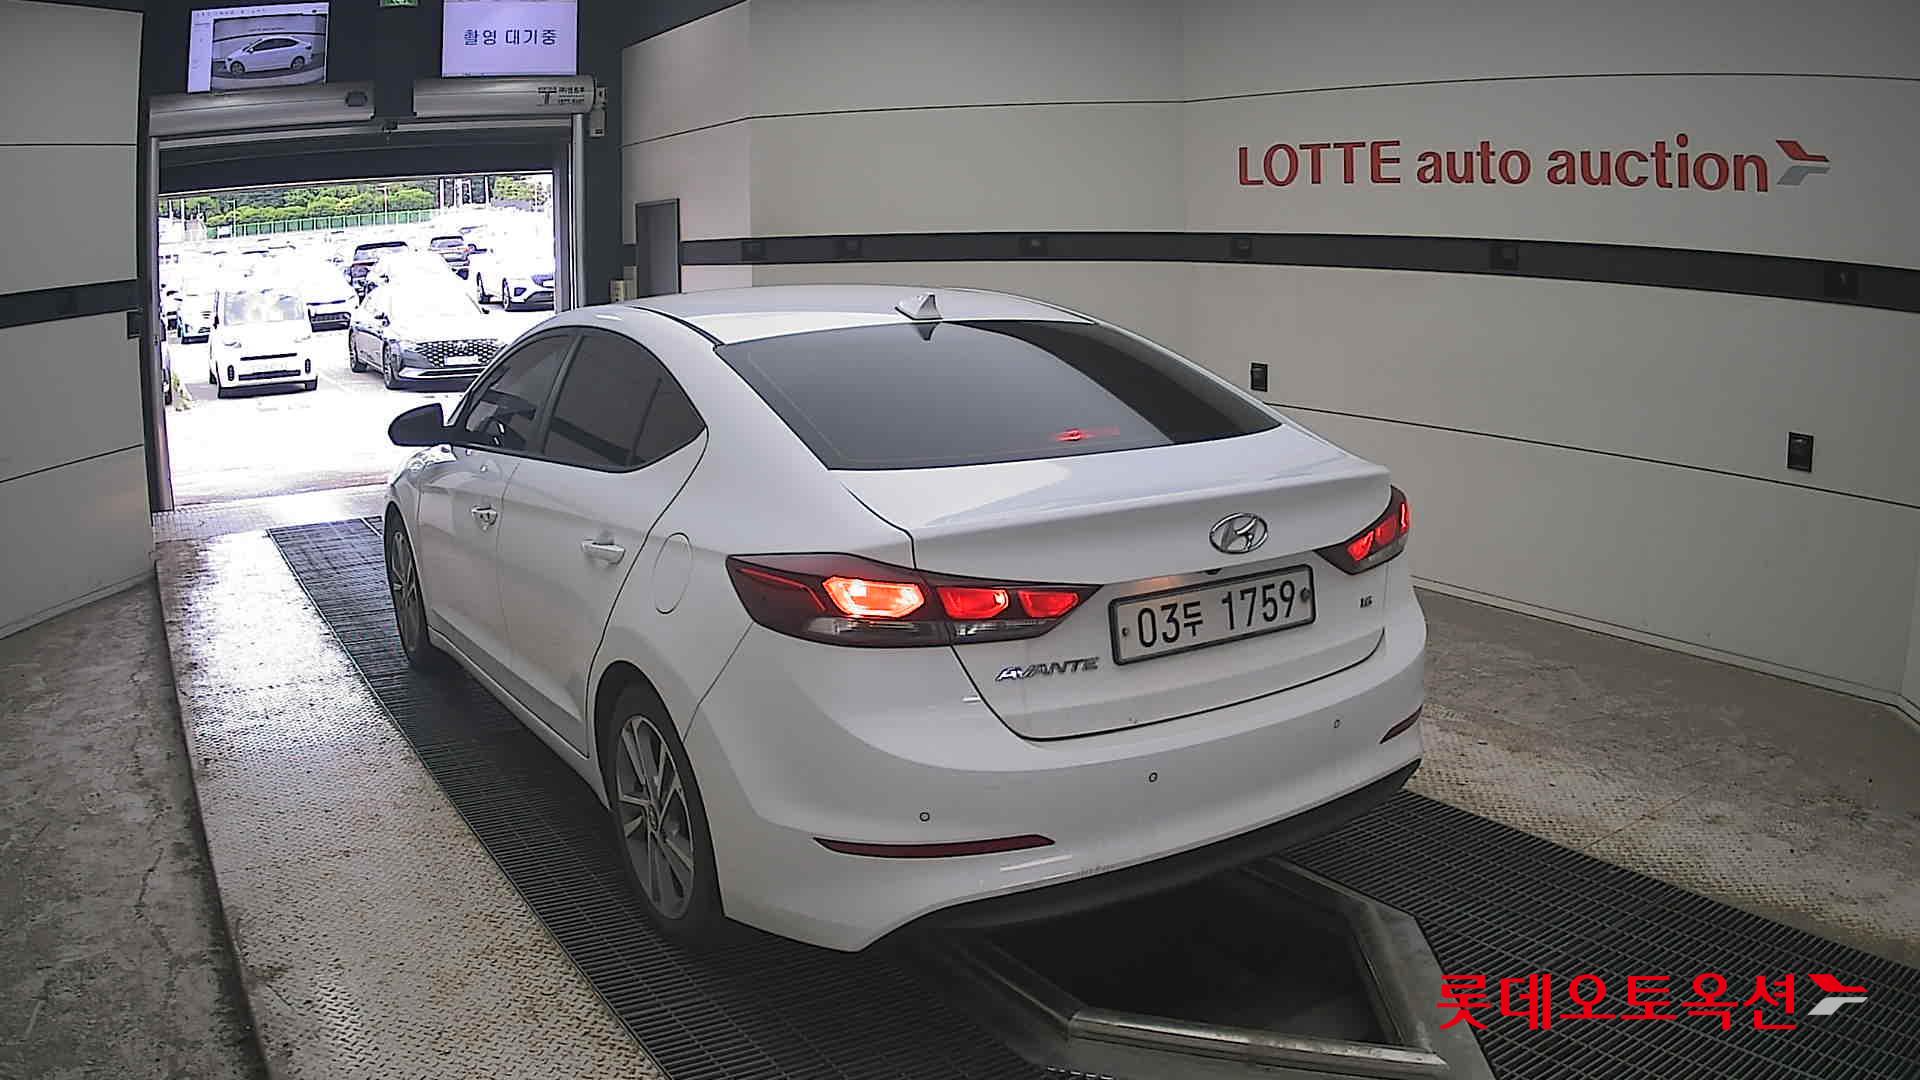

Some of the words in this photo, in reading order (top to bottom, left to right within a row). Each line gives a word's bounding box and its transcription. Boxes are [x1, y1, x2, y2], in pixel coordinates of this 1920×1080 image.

[505, 29, 557, 46] 대기중
[1240, 141, 1399, 187] LOTTE
[1418, 142, 1531, 185] auto
[1548, 134, 1768, 192] auction
[1137, 601, 1203, 648] 03두
[1221, 580, 1295, 631] 1759
[994, 656, 1100, 682] AVANTE
